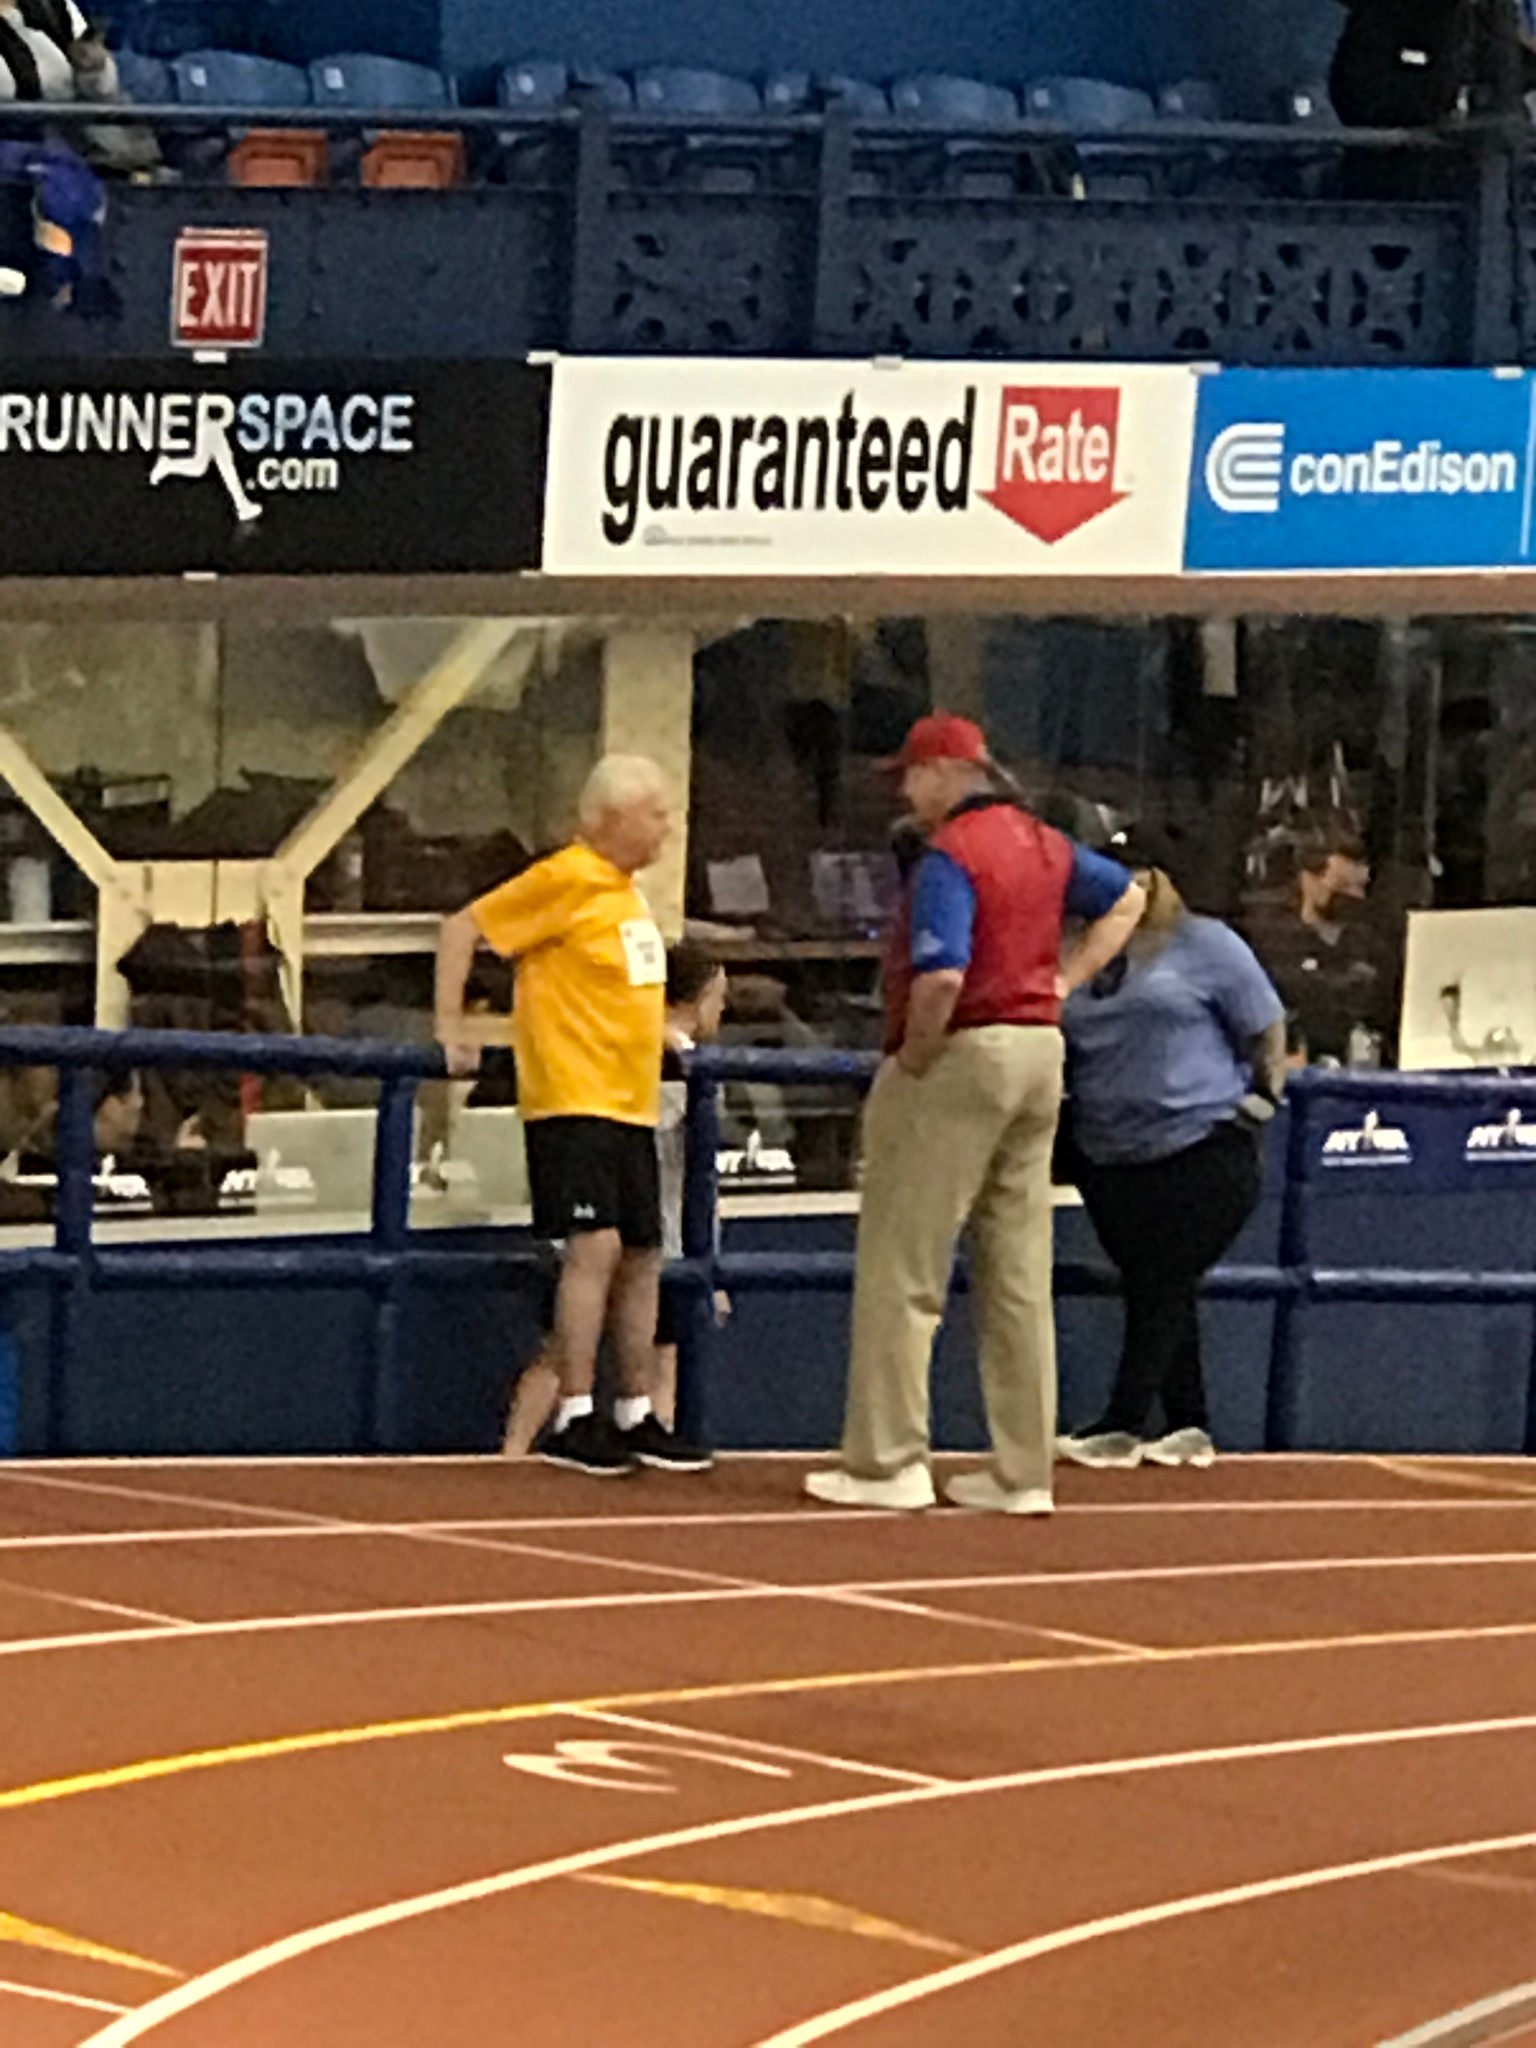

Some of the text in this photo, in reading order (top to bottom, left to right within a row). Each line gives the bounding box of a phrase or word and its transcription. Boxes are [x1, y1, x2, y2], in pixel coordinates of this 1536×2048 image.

[180, 261, 259, 328] EXIT
[0, 392, 415, 453] RUNNERSPACE
[601, 386, 1111, 547] guaranteed Rate
[1289, 440, 1517, 496] conEdison
